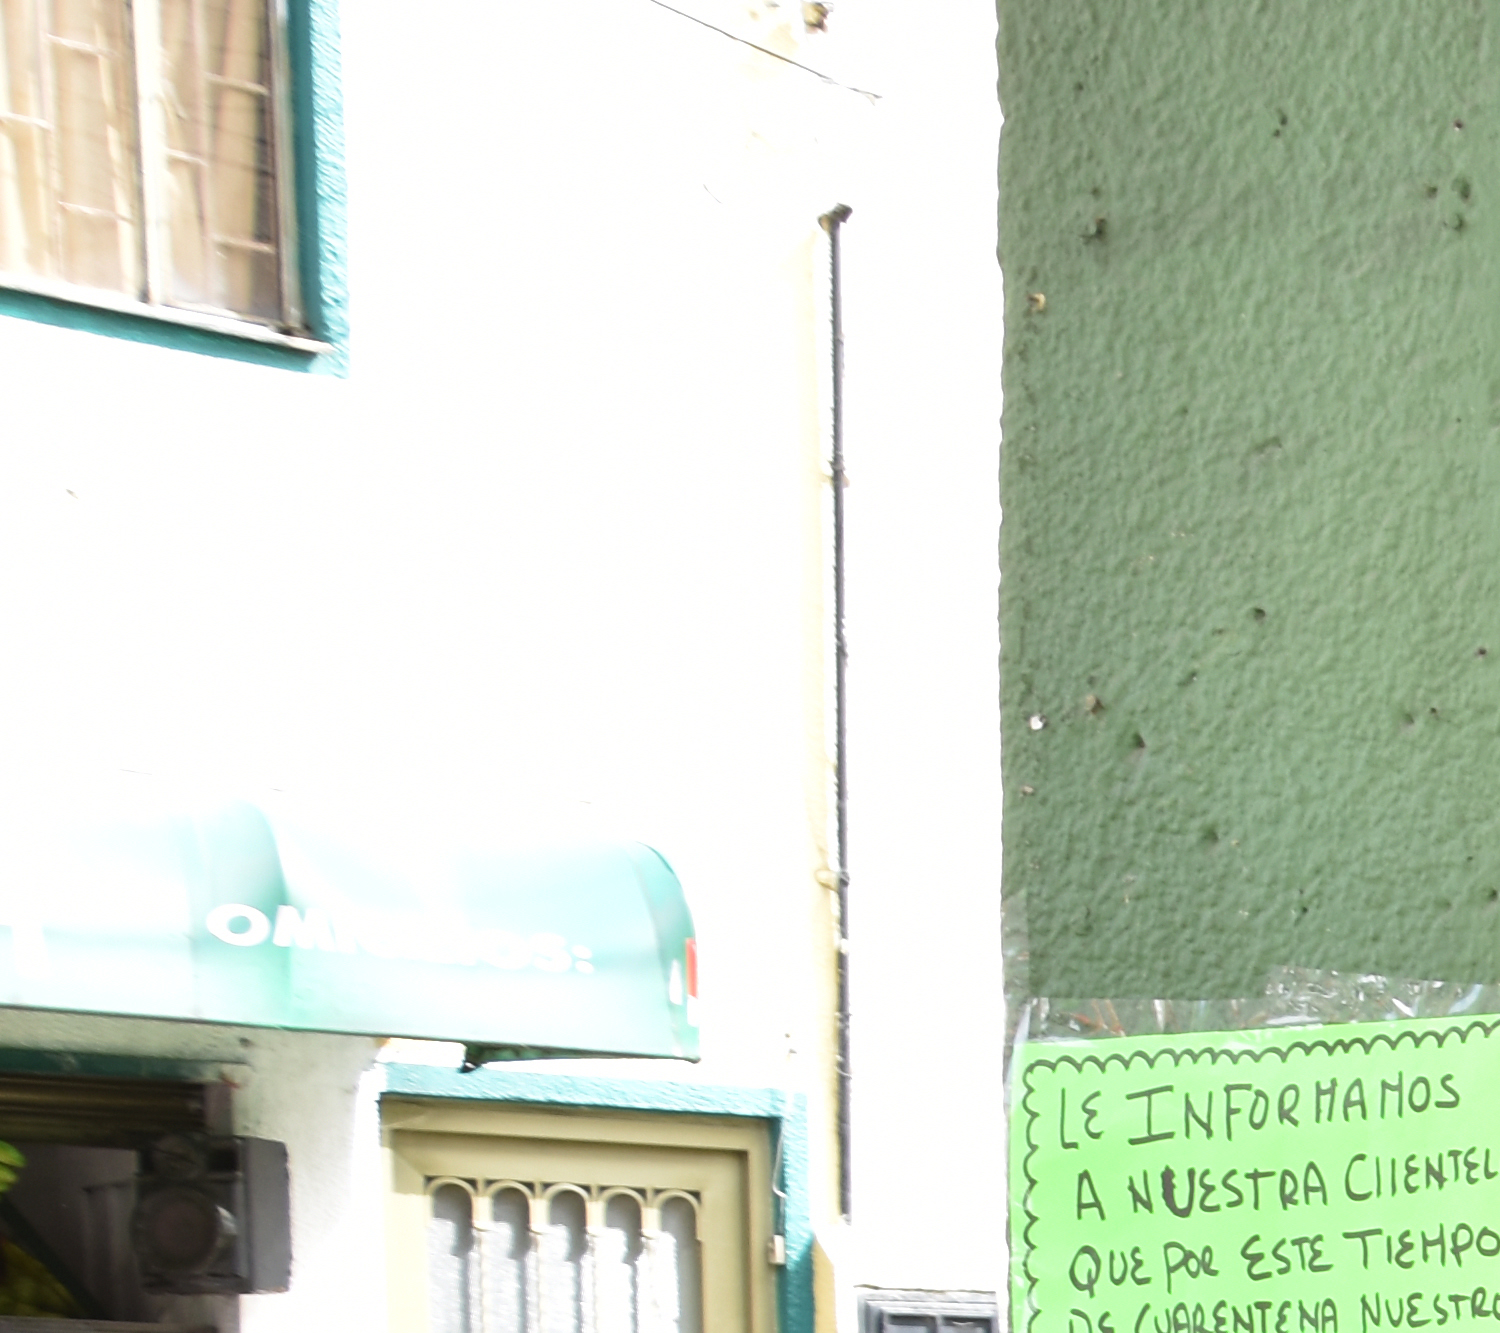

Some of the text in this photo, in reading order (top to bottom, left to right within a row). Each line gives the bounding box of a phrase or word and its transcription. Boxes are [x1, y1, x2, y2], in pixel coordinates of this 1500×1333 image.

[1060, 1088, 1105, 1149] LE
[1076, 1170, 1107, 1221] A
[1127, 1162, 1328, 1218] NUESTRA
[1068, 1245, 1152, 1298] QUE
[1163, 1242, 1220, 1293] POR
[1240, 1233, 1333, 1282] ESTE
